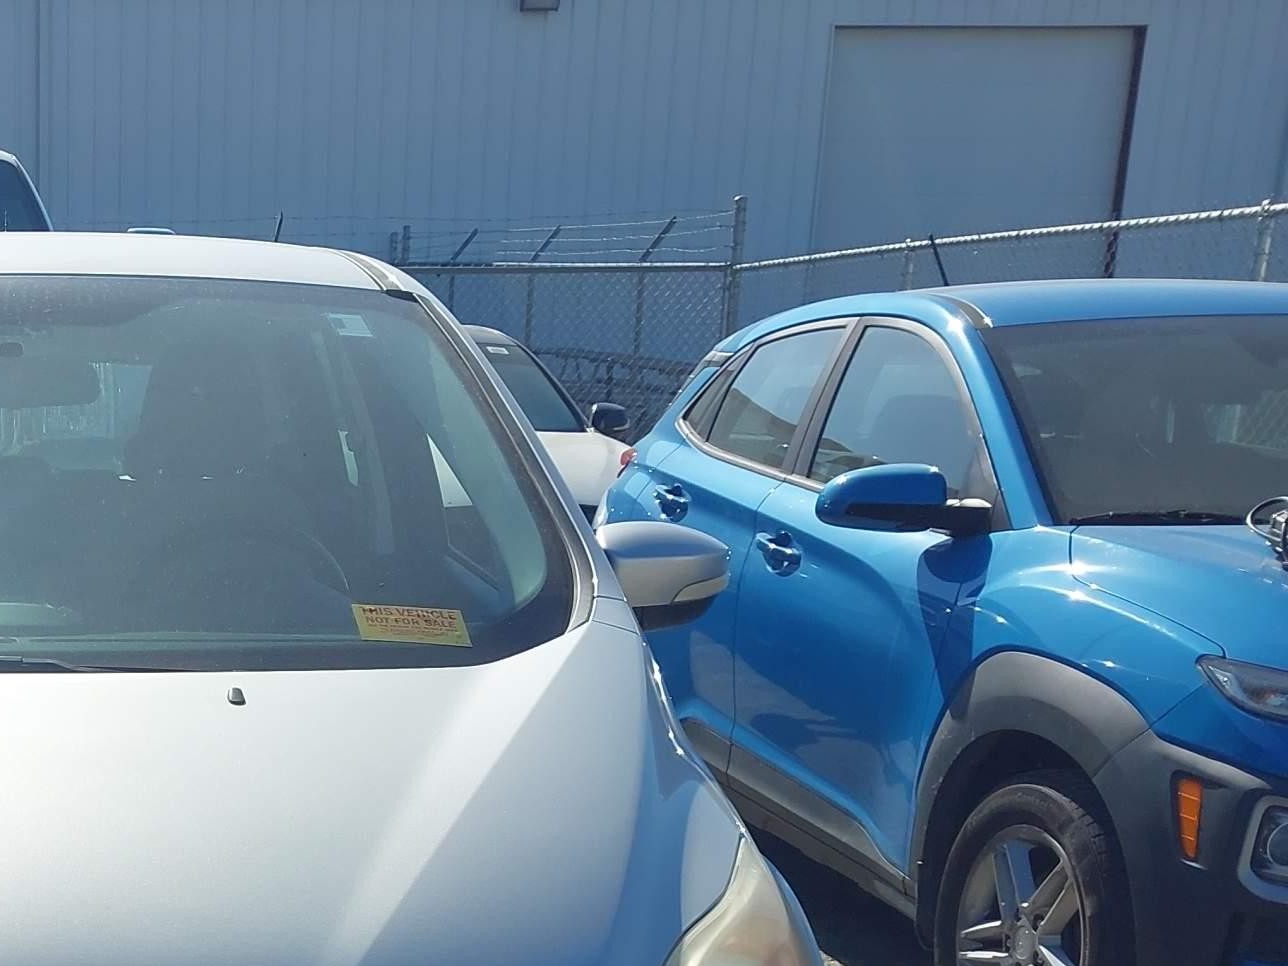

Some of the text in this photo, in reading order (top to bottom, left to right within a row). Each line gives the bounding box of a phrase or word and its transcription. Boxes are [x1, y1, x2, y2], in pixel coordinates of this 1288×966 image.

[365, 616, 458, 629] NOT FOR SALE
